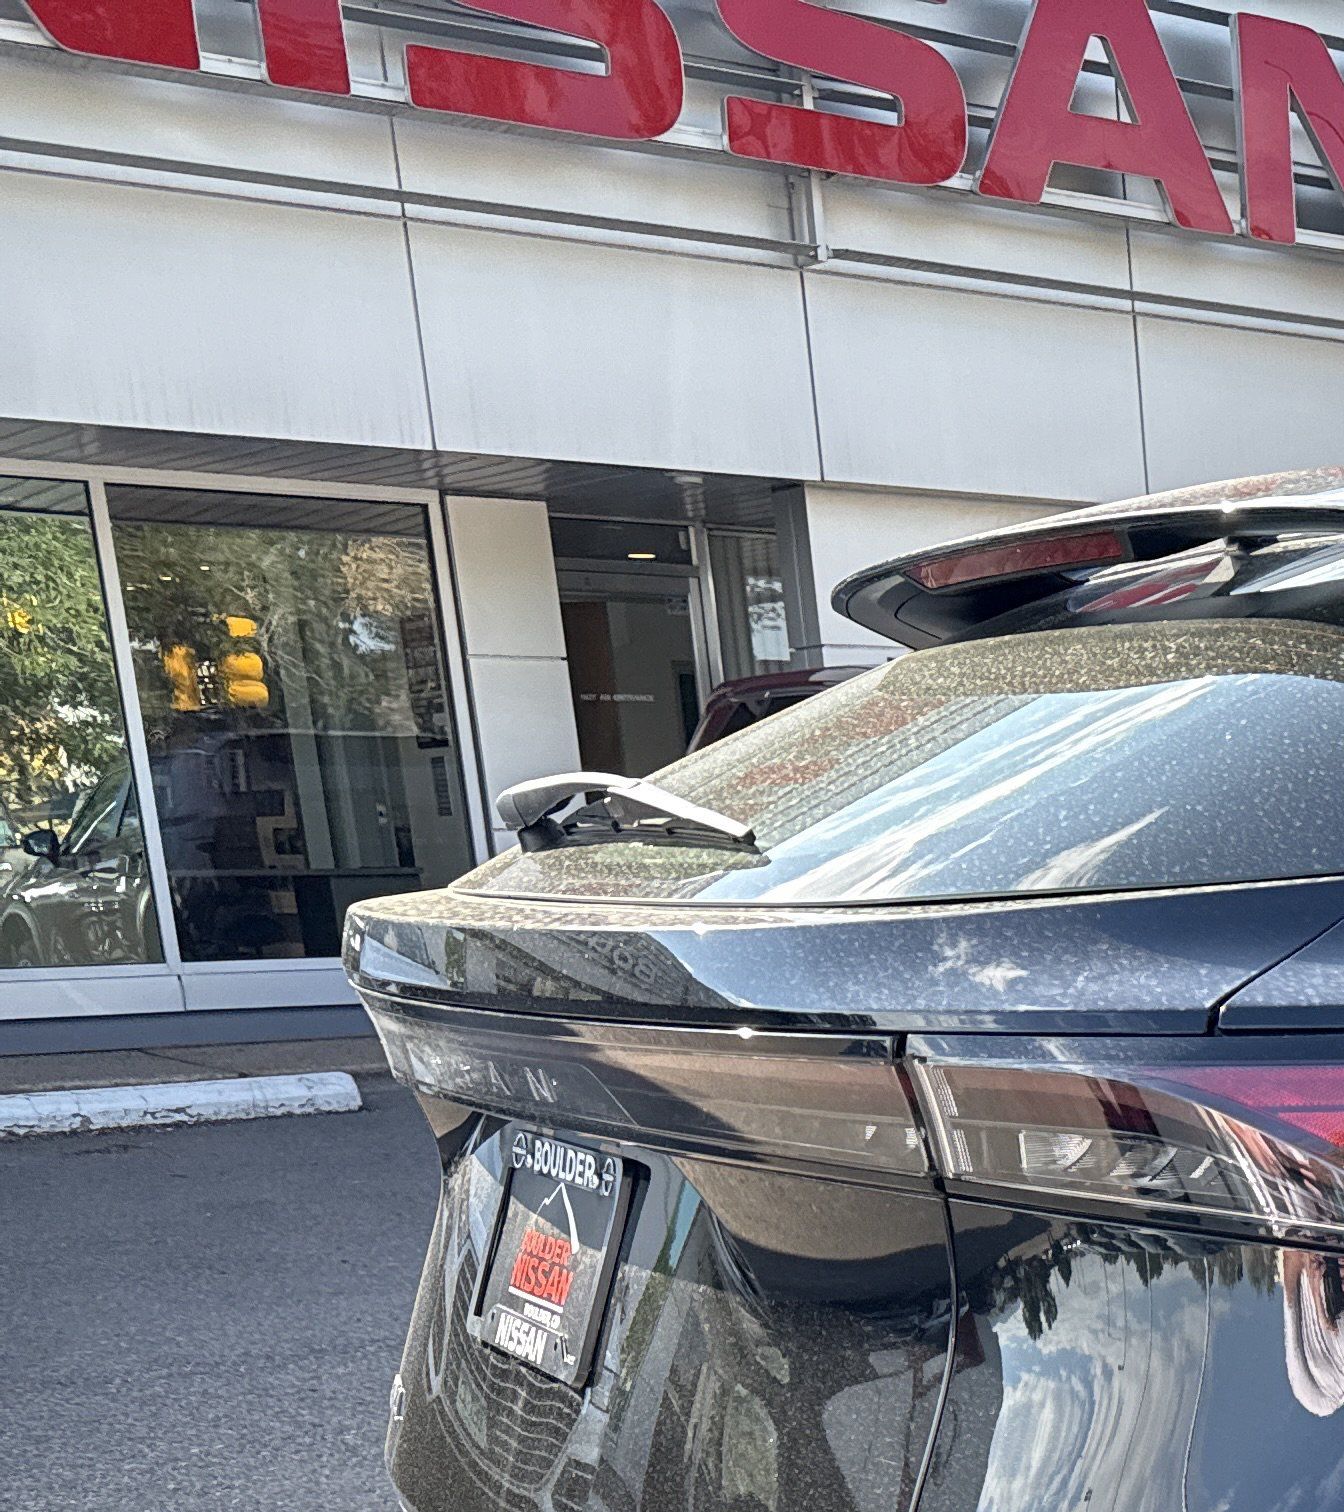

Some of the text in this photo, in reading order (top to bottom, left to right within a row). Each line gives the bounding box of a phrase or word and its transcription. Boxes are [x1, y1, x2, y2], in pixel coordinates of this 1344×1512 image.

[533, 1139, 594, 1188] BOULDER
[511, 1254, 574, 1306] NISSAN
[495, 1312, 548, 1365] NISSAN
